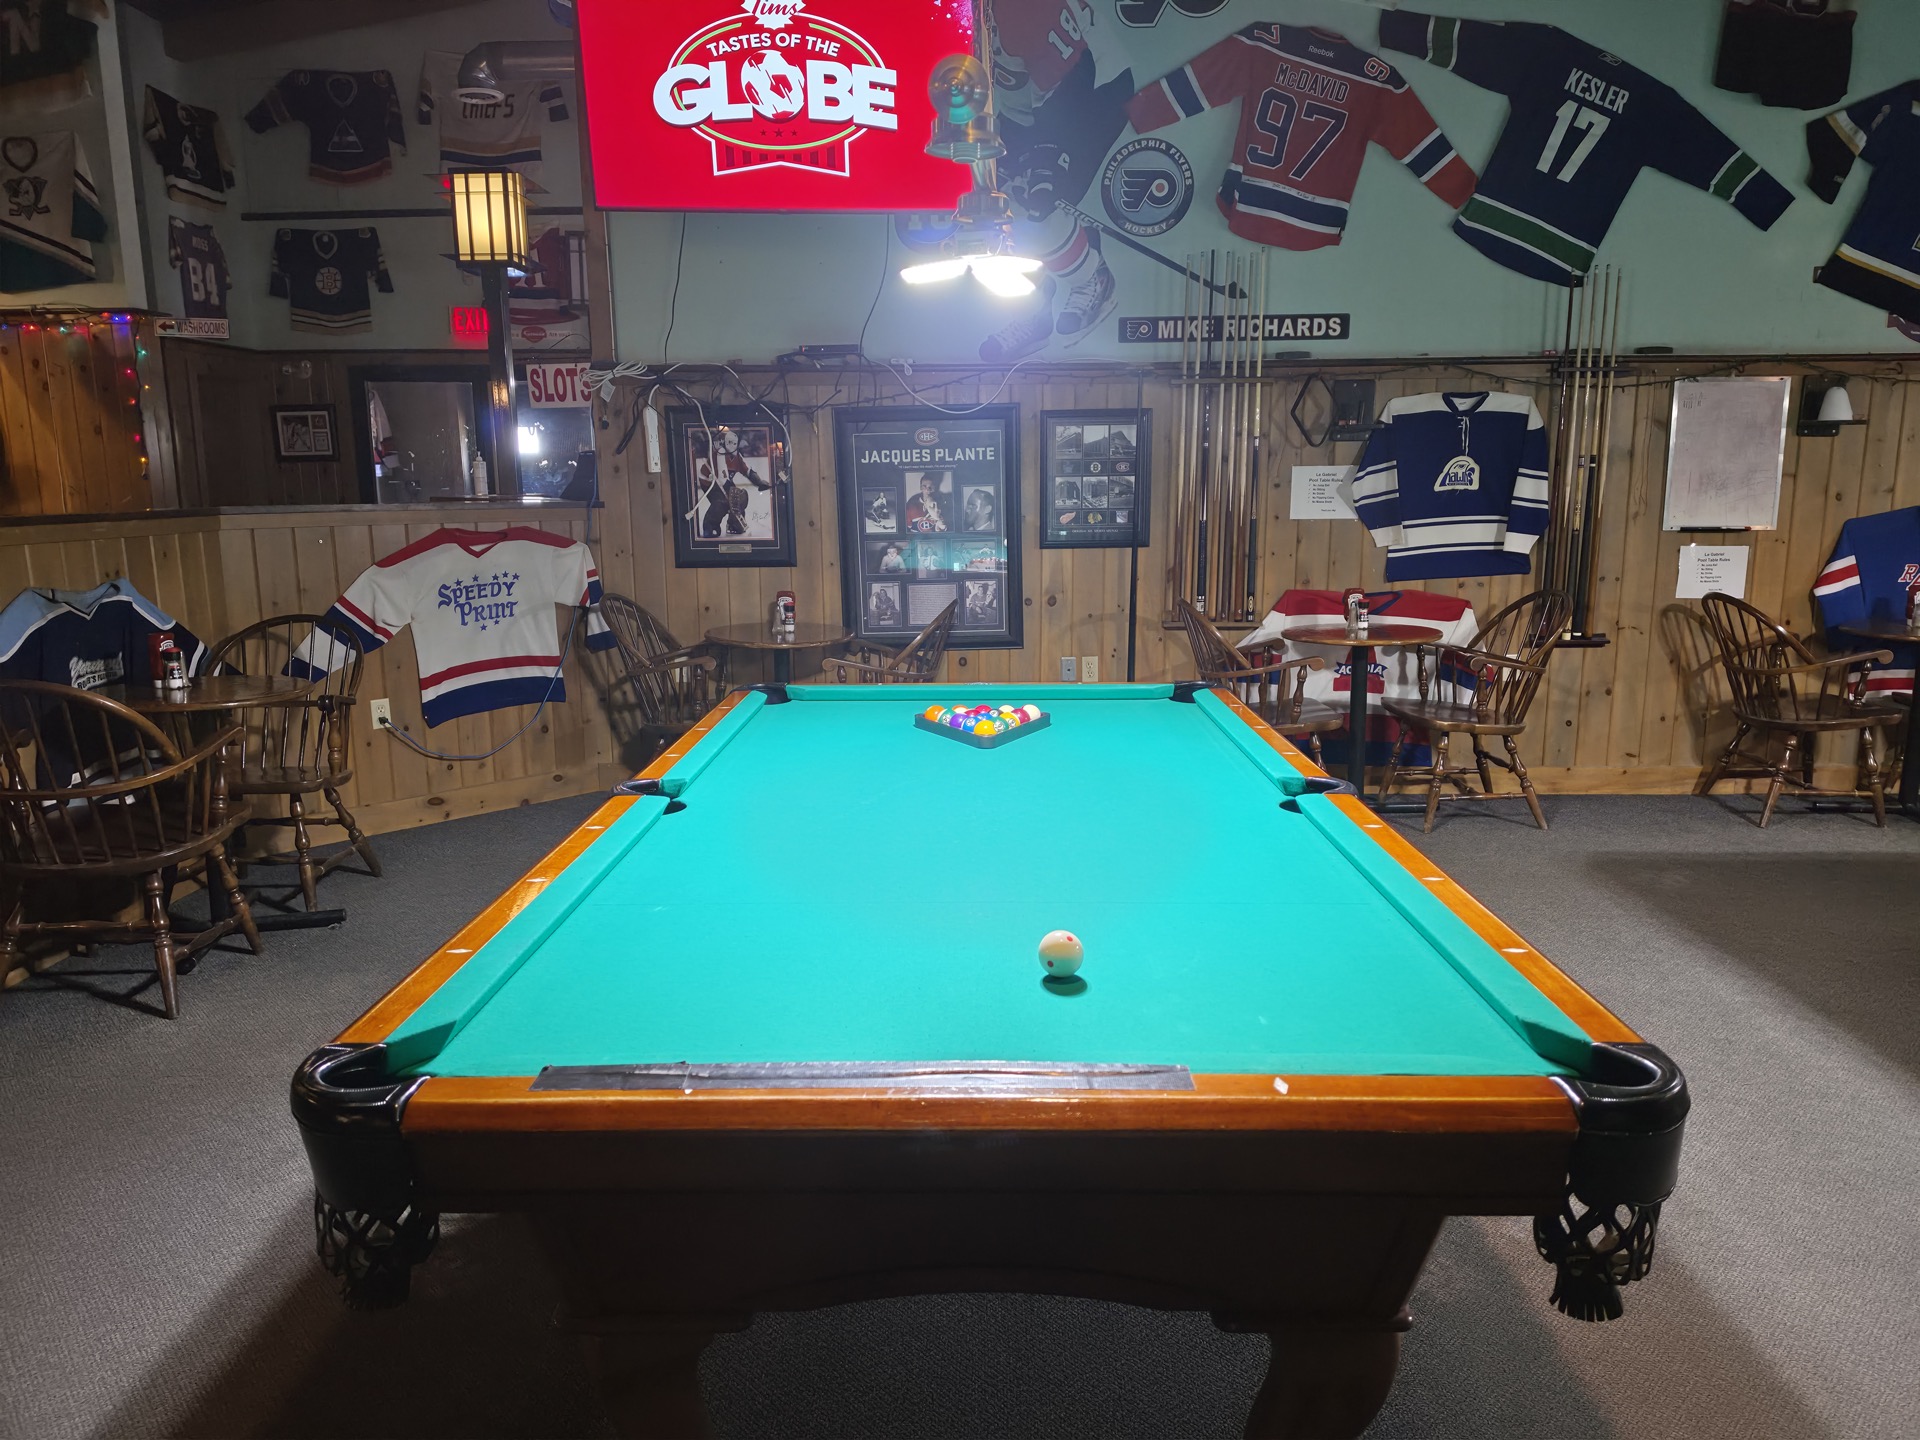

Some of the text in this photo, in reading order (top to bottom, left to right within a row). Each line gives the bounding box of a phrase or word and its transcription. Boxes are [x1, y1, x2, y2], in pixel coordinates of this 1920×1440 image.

[706, 32, 841, 58] TASTES OF THE
[1308, 45, 1335, 58] Reebok
[652, 49, 898, 130] GLOBE
[1275, 62, 1350, 103] McDAVID
[1563, 67, 1630, 114] KESLER
[1246, 86, 1349, 181] 97
[1536, 99, 1612, 184] 17
[1104, 140, 1193, 185] PHILADELPHIA FLYERS
[1124, 222, 1168, 234] HOCKEY
[176, 321, 226, 335] WASHROOMS
[453, 307, 490, 331] EXIT
[1158, 317, 1342, 339] MIKE RICHARDS
[530, 367, 593, 404] SLOTS
[861, 447, 995, 465] JACQUES PLANTE
[438, 581, 516, 610] SPEEDY
[454, 600, 519, 626] PRINT
[1338, 663, 1383, 675] ACIA
